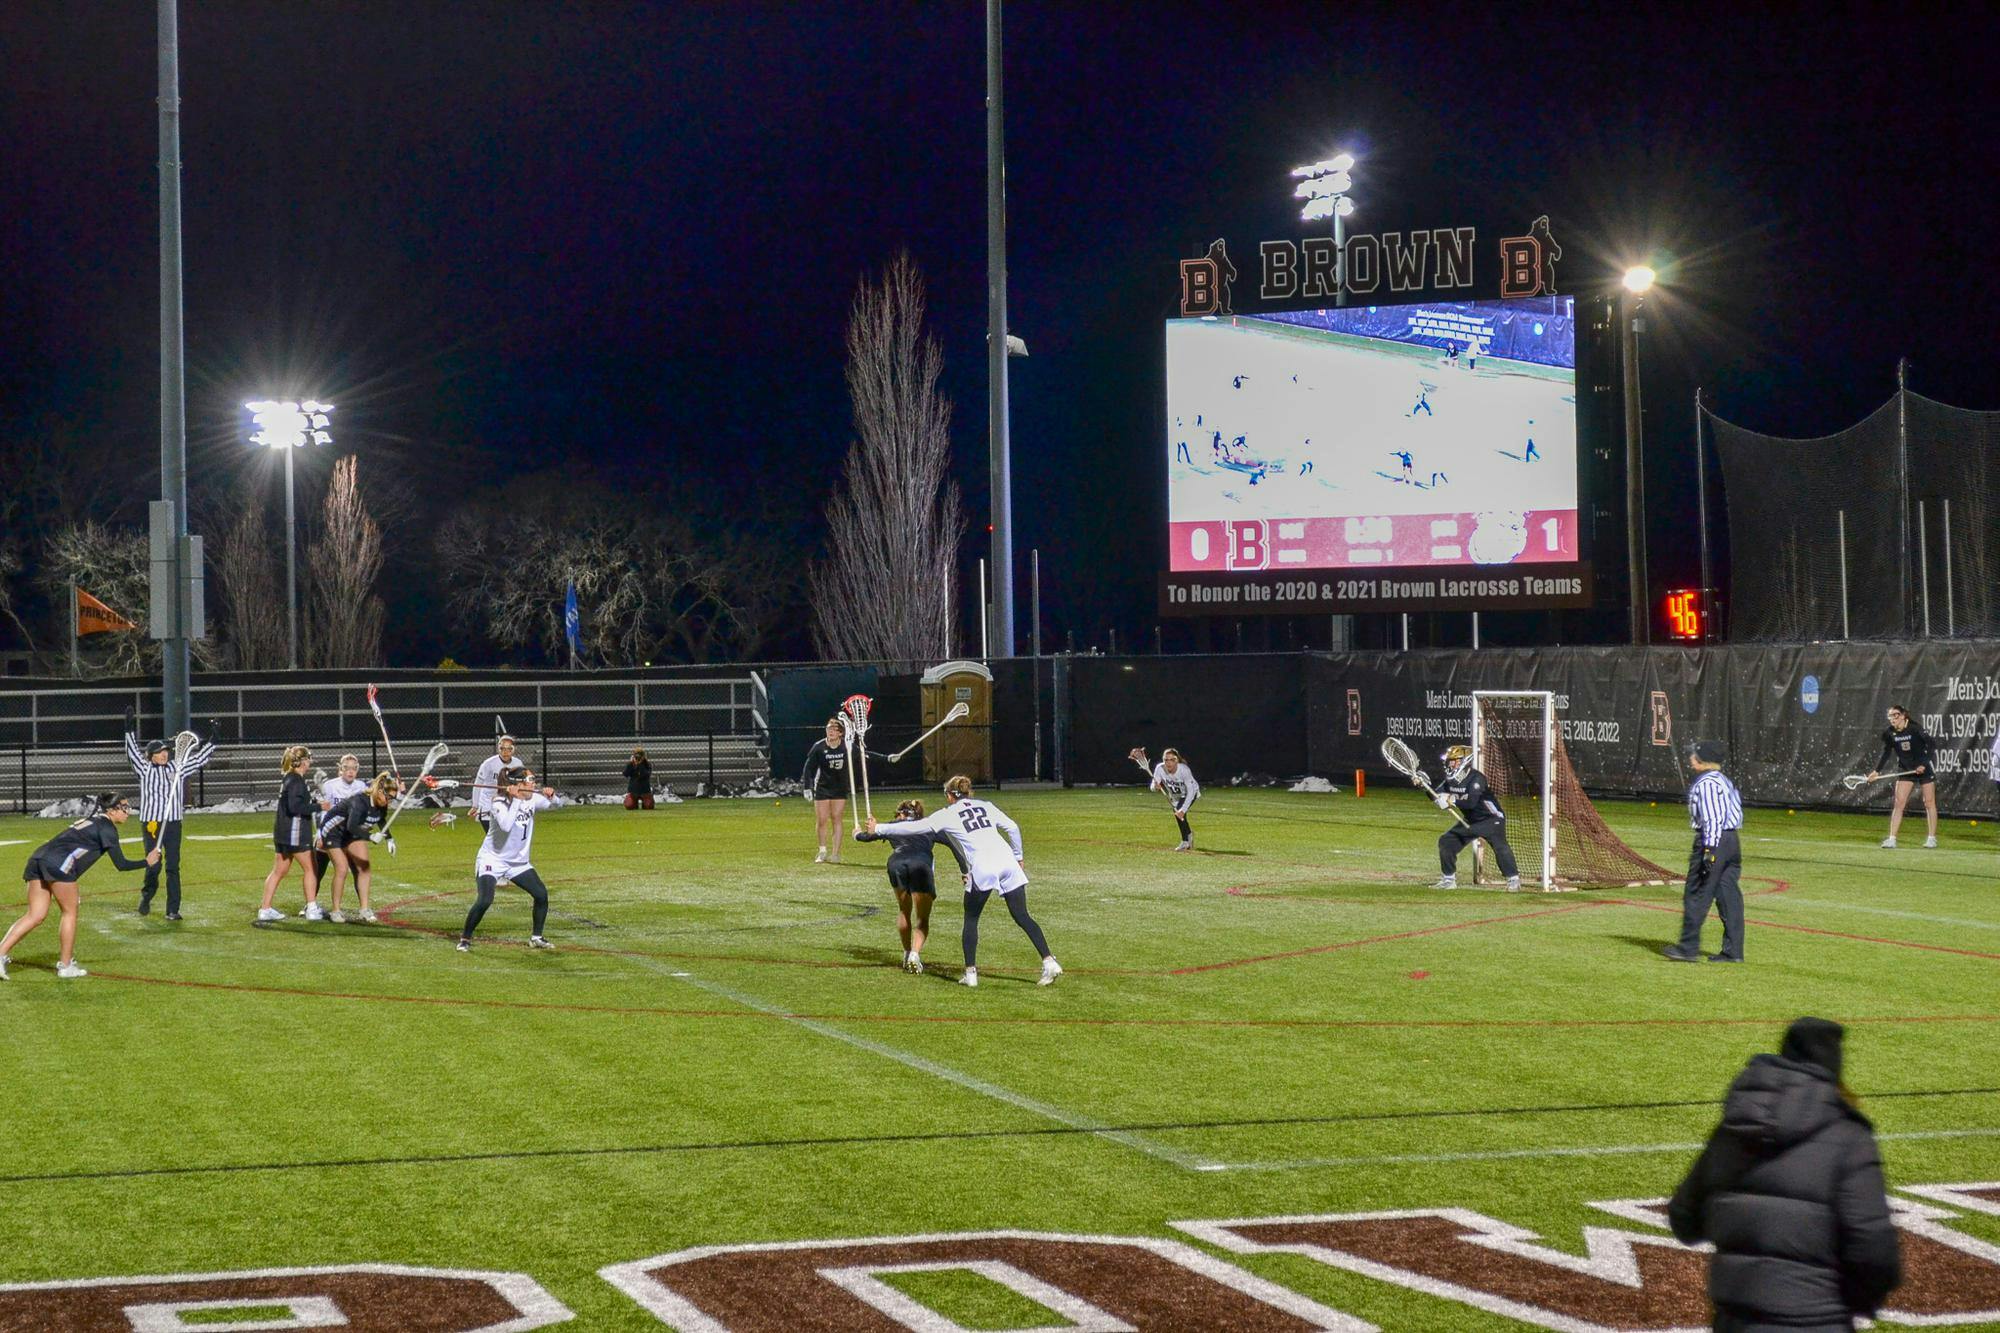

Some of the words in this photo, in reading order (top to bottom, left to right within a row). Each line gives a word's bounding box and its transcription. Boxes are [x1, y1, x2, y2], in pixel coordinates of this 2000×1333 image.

[1260, 227, 1475, 299] BROWN
[1500, 237, 1541, 298] B
[1180, 258, 1219, 317] B
[1226, 519, 1270, 571] B
[1541, 517, 1558, 551] 1
[1168, 585, 1186, 602] To
[1191, 584, 1240, 602] Honor
[1244, 583, 1270, 601] the
[1275, 581, 1316, 600] 2020
[1321, 583, 1333, 599] &
[1337, 580, 1376, 599] 2021
[1381, 580, 1435, 598] Brown
[1440, 578, 1519, 597] Lacrosse
[1523, 576, 1582, 595] Teams
[1669, 593, 1697, 634] 46
[1426, 690, 1447, 708] Men's
[1448, 690, 1476, 709] Lacros
[1947, 676, 1983, 701] Men's
[1347, 688, 1361, 735] B
[1651, 691, 1671, 745] B
[1922, 714, 1949, 741] 1971,
[1950, 713, 1981, 740] 1973,
[1405, 717, 1424, 739] 1973,
[1573, 720, 1596, 744] 2016,
[1597, 721, 1620, 742] 2022
[1935, 748, 1966, 775] 1994,
[521, 823, 528, 841] 1
[958, 806, 992, 833] 22
